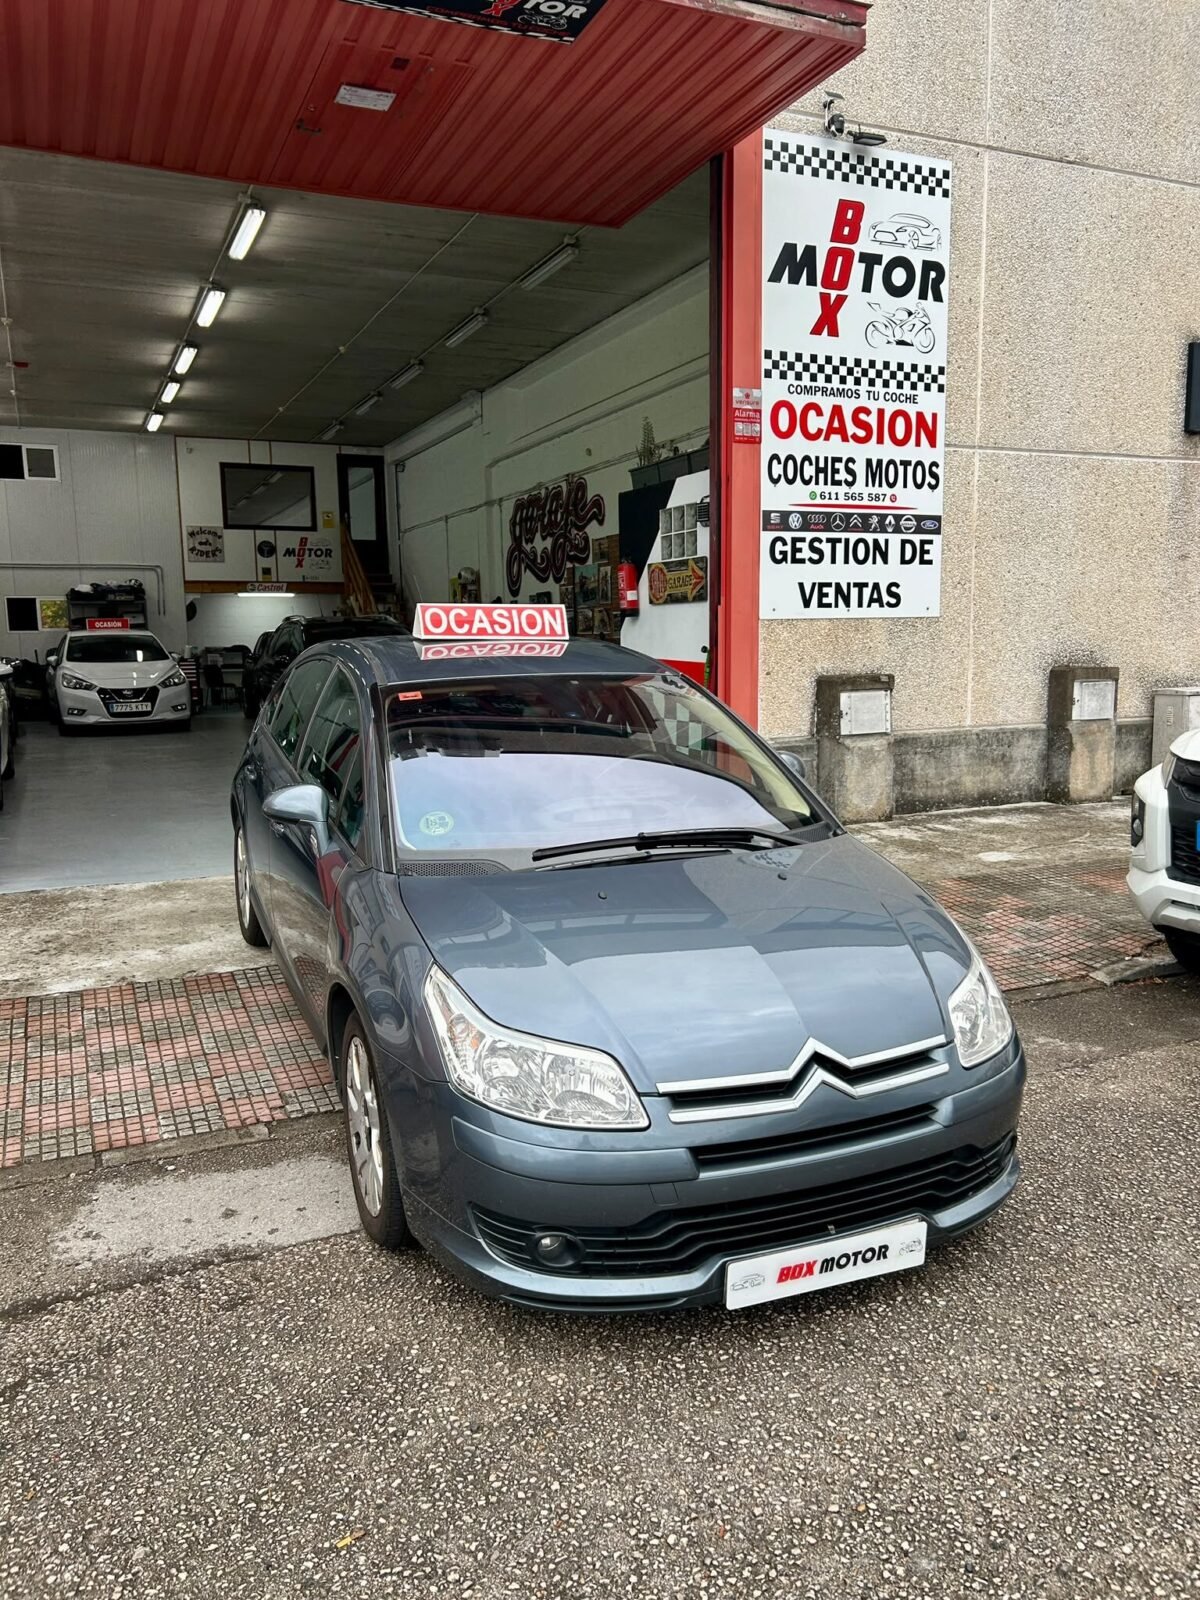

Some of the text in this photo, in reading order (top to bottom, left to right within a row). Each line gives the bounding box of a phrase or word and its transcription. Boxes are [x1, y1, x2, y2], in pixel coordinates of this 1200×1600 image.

[809, 198, 865, 338] BOX
[788, 384, 919, 405] COMPRAMOS TU COCHE
[735, 409, 760, 418] Alarma
[770, 399, 938, 448] OCASION
[767, 453, 940, 491] COCHES MOTOS
[819, 491, 887, 502] 611 565 587
[769, 536, 934, 566] GESTION DE
[257, 583, 284, 592] Castrol
[798, 581, 901, 608] VENTAS
[424, 607, 563, 635] OCASION
[776, 1244, 889, 1284] BOX MOTOR
